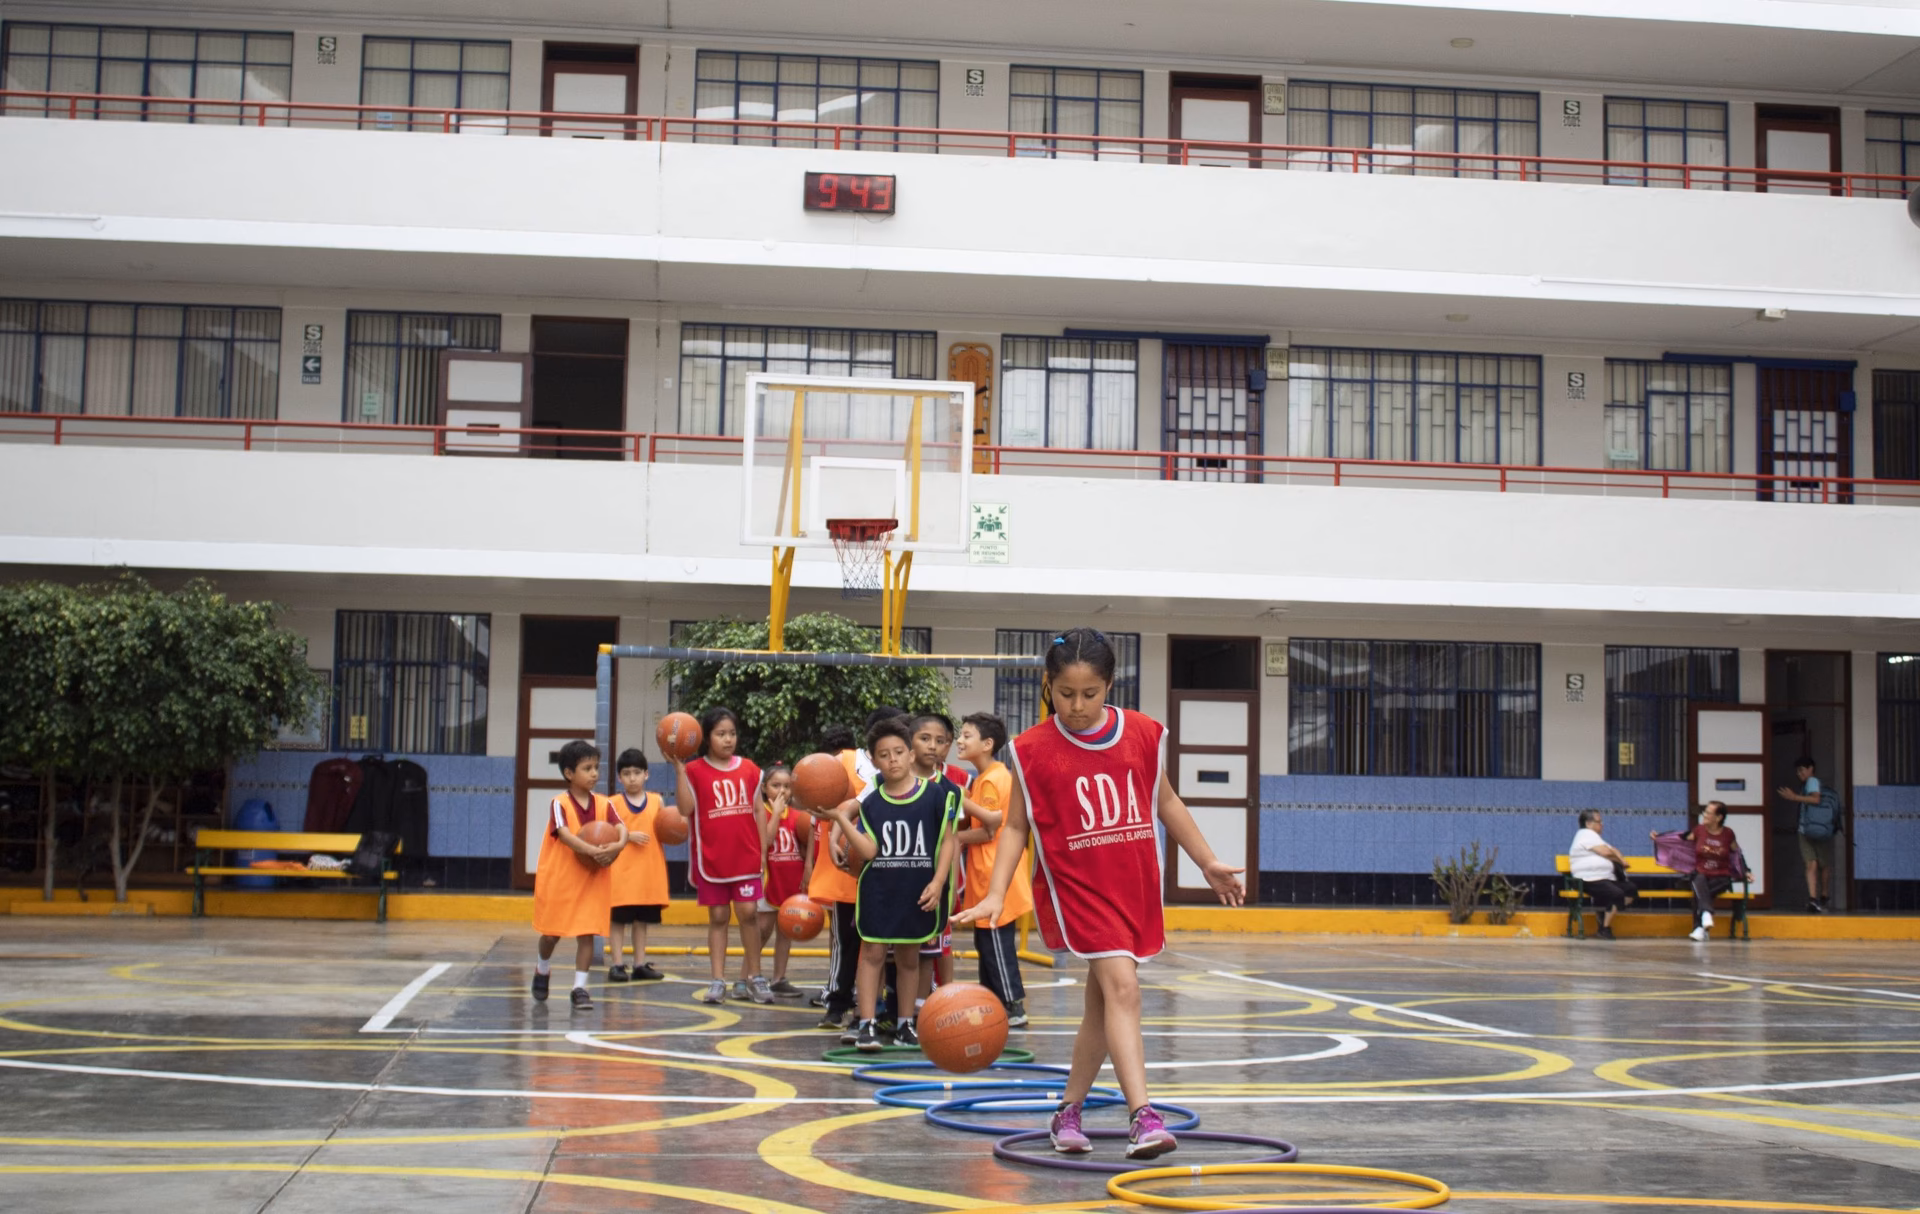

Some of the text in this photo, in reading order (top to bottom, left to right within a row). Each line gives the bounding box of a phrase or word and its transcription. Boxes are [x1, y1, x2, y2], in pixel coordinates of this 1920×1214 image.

[320, 38, 335, 51] S
[969, 70, 983, 84] S
[1267, 95, 1282, 104] 579
[1565, 101, 1579, 115] S
[306, 326, 321, 340] S
[1570, 373, 1584, 387] S
[1271, 656, 1284, 664] 492
[1569, 675, 1582, 689] S
[712, 777, 749, 809] SDA
[1075, 768, 1142, 831] SDA
[881, 819, 928, 857] SDA
[1068, 838, 1091, 852] SANTO
[1091, 832, 1126, 848] DOMINGO,
[1126, 831, 1134, 841] EL
